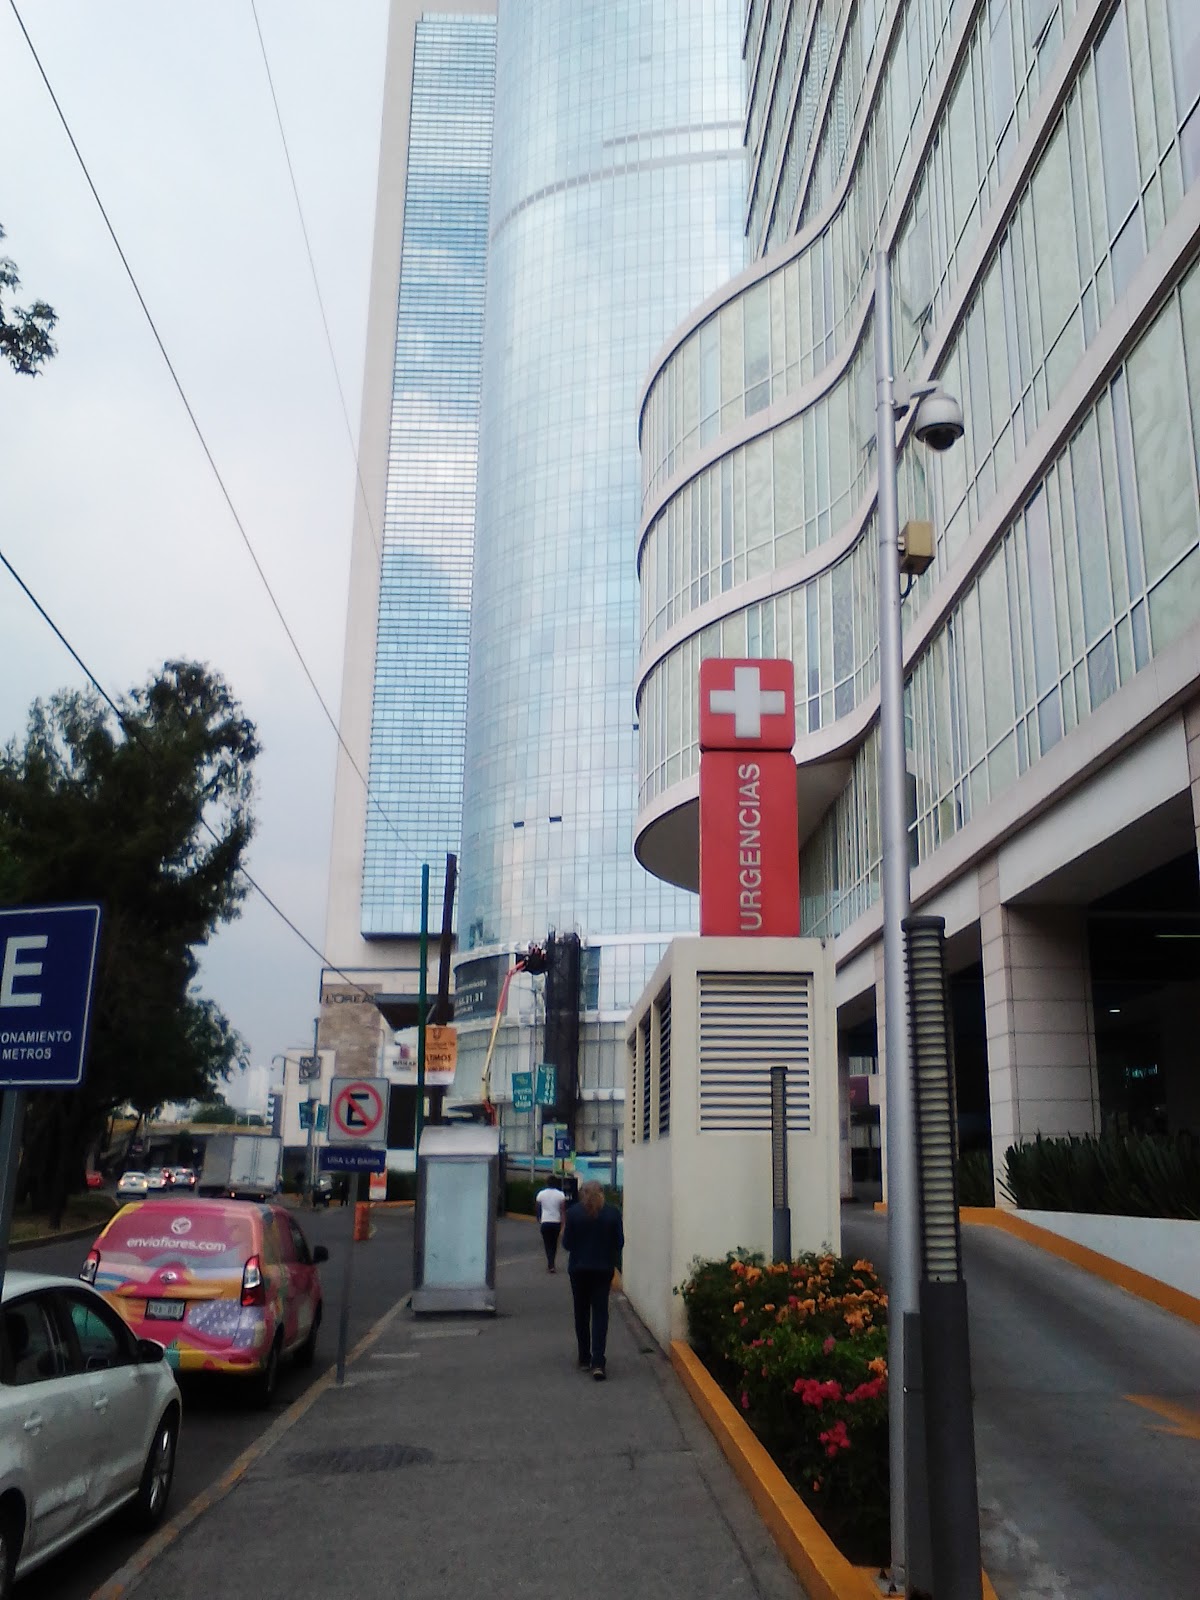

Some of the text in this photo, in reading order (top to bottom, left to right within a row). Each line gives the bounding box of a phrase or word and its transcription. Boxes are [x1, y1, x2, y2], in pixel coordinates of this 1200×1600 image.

[738, 762, 763, 931] URGENCIAS
[0, 934, 49, 1009] E
[2, 1048, 52, 1060] METROS
[126, 1236, 227, 1253] enviaflores.com
